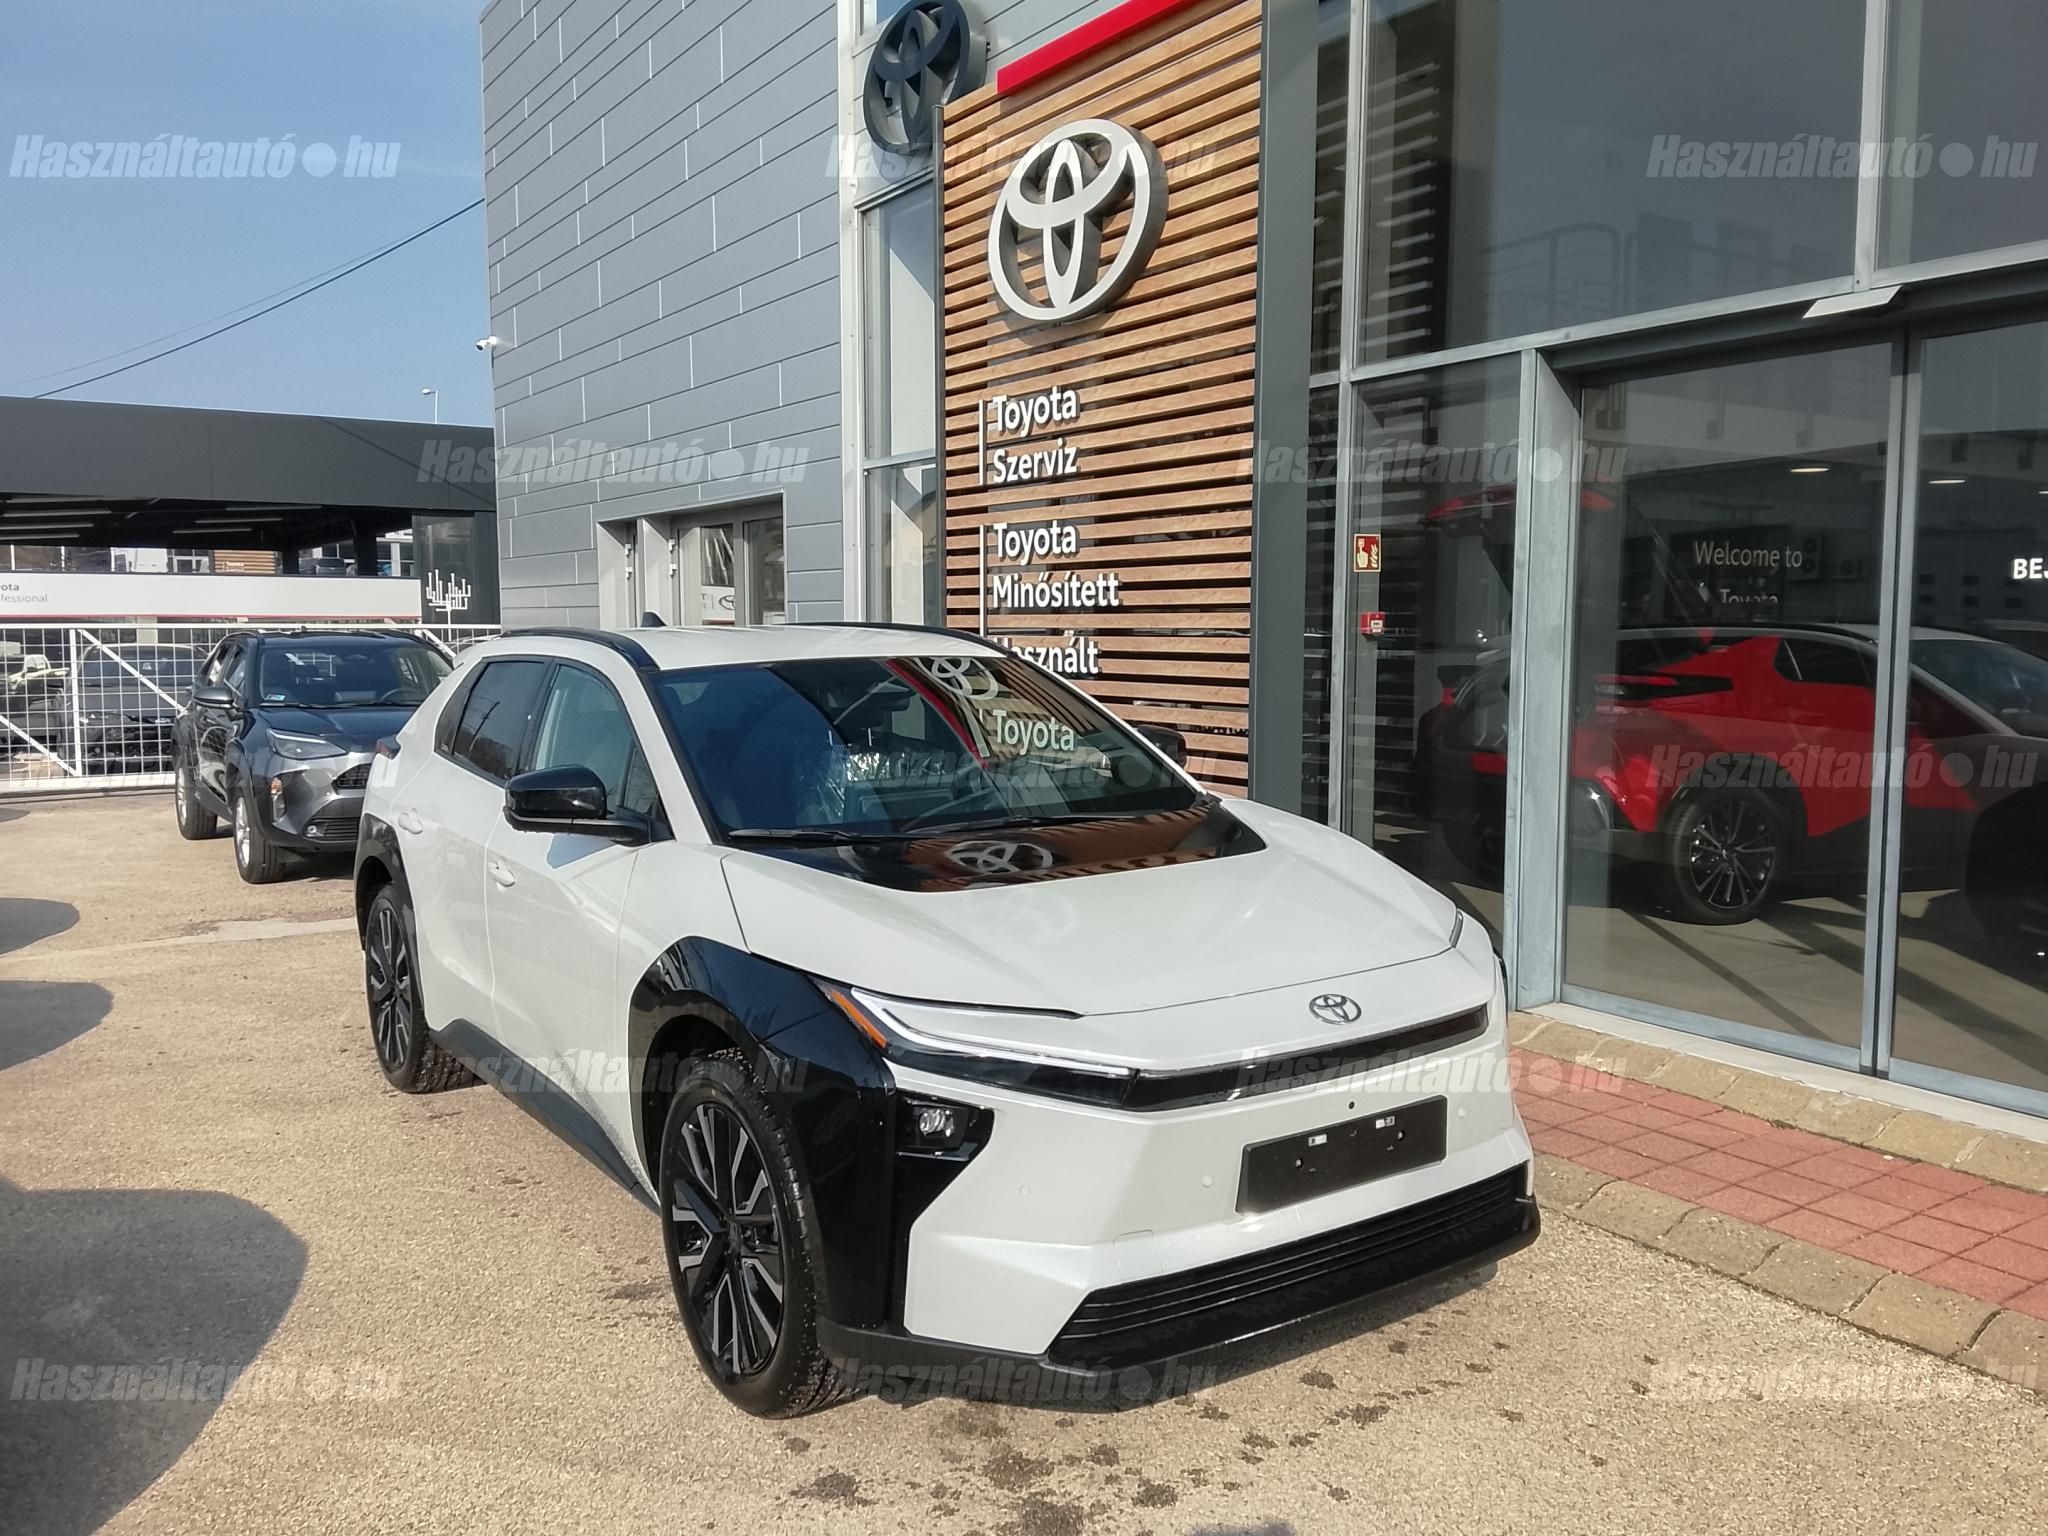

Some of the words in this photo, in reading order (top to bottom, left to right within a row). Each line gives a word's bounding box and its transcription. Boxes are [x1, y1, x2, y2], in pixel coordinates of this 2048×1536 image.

[992, 385, 1077, 437] Toyota
[993, 437, 1077, 483] Szerviz
[993, 520, 1077, 565] Toyota
[1694, 540, 1780, 567] Welcome
[1786, 547, 1803, 568] to
[993, 571, 1119, 608] Minősített
[993, 636, 1099, 674] sznált
[992, 709, 1074, 755] Toyota
